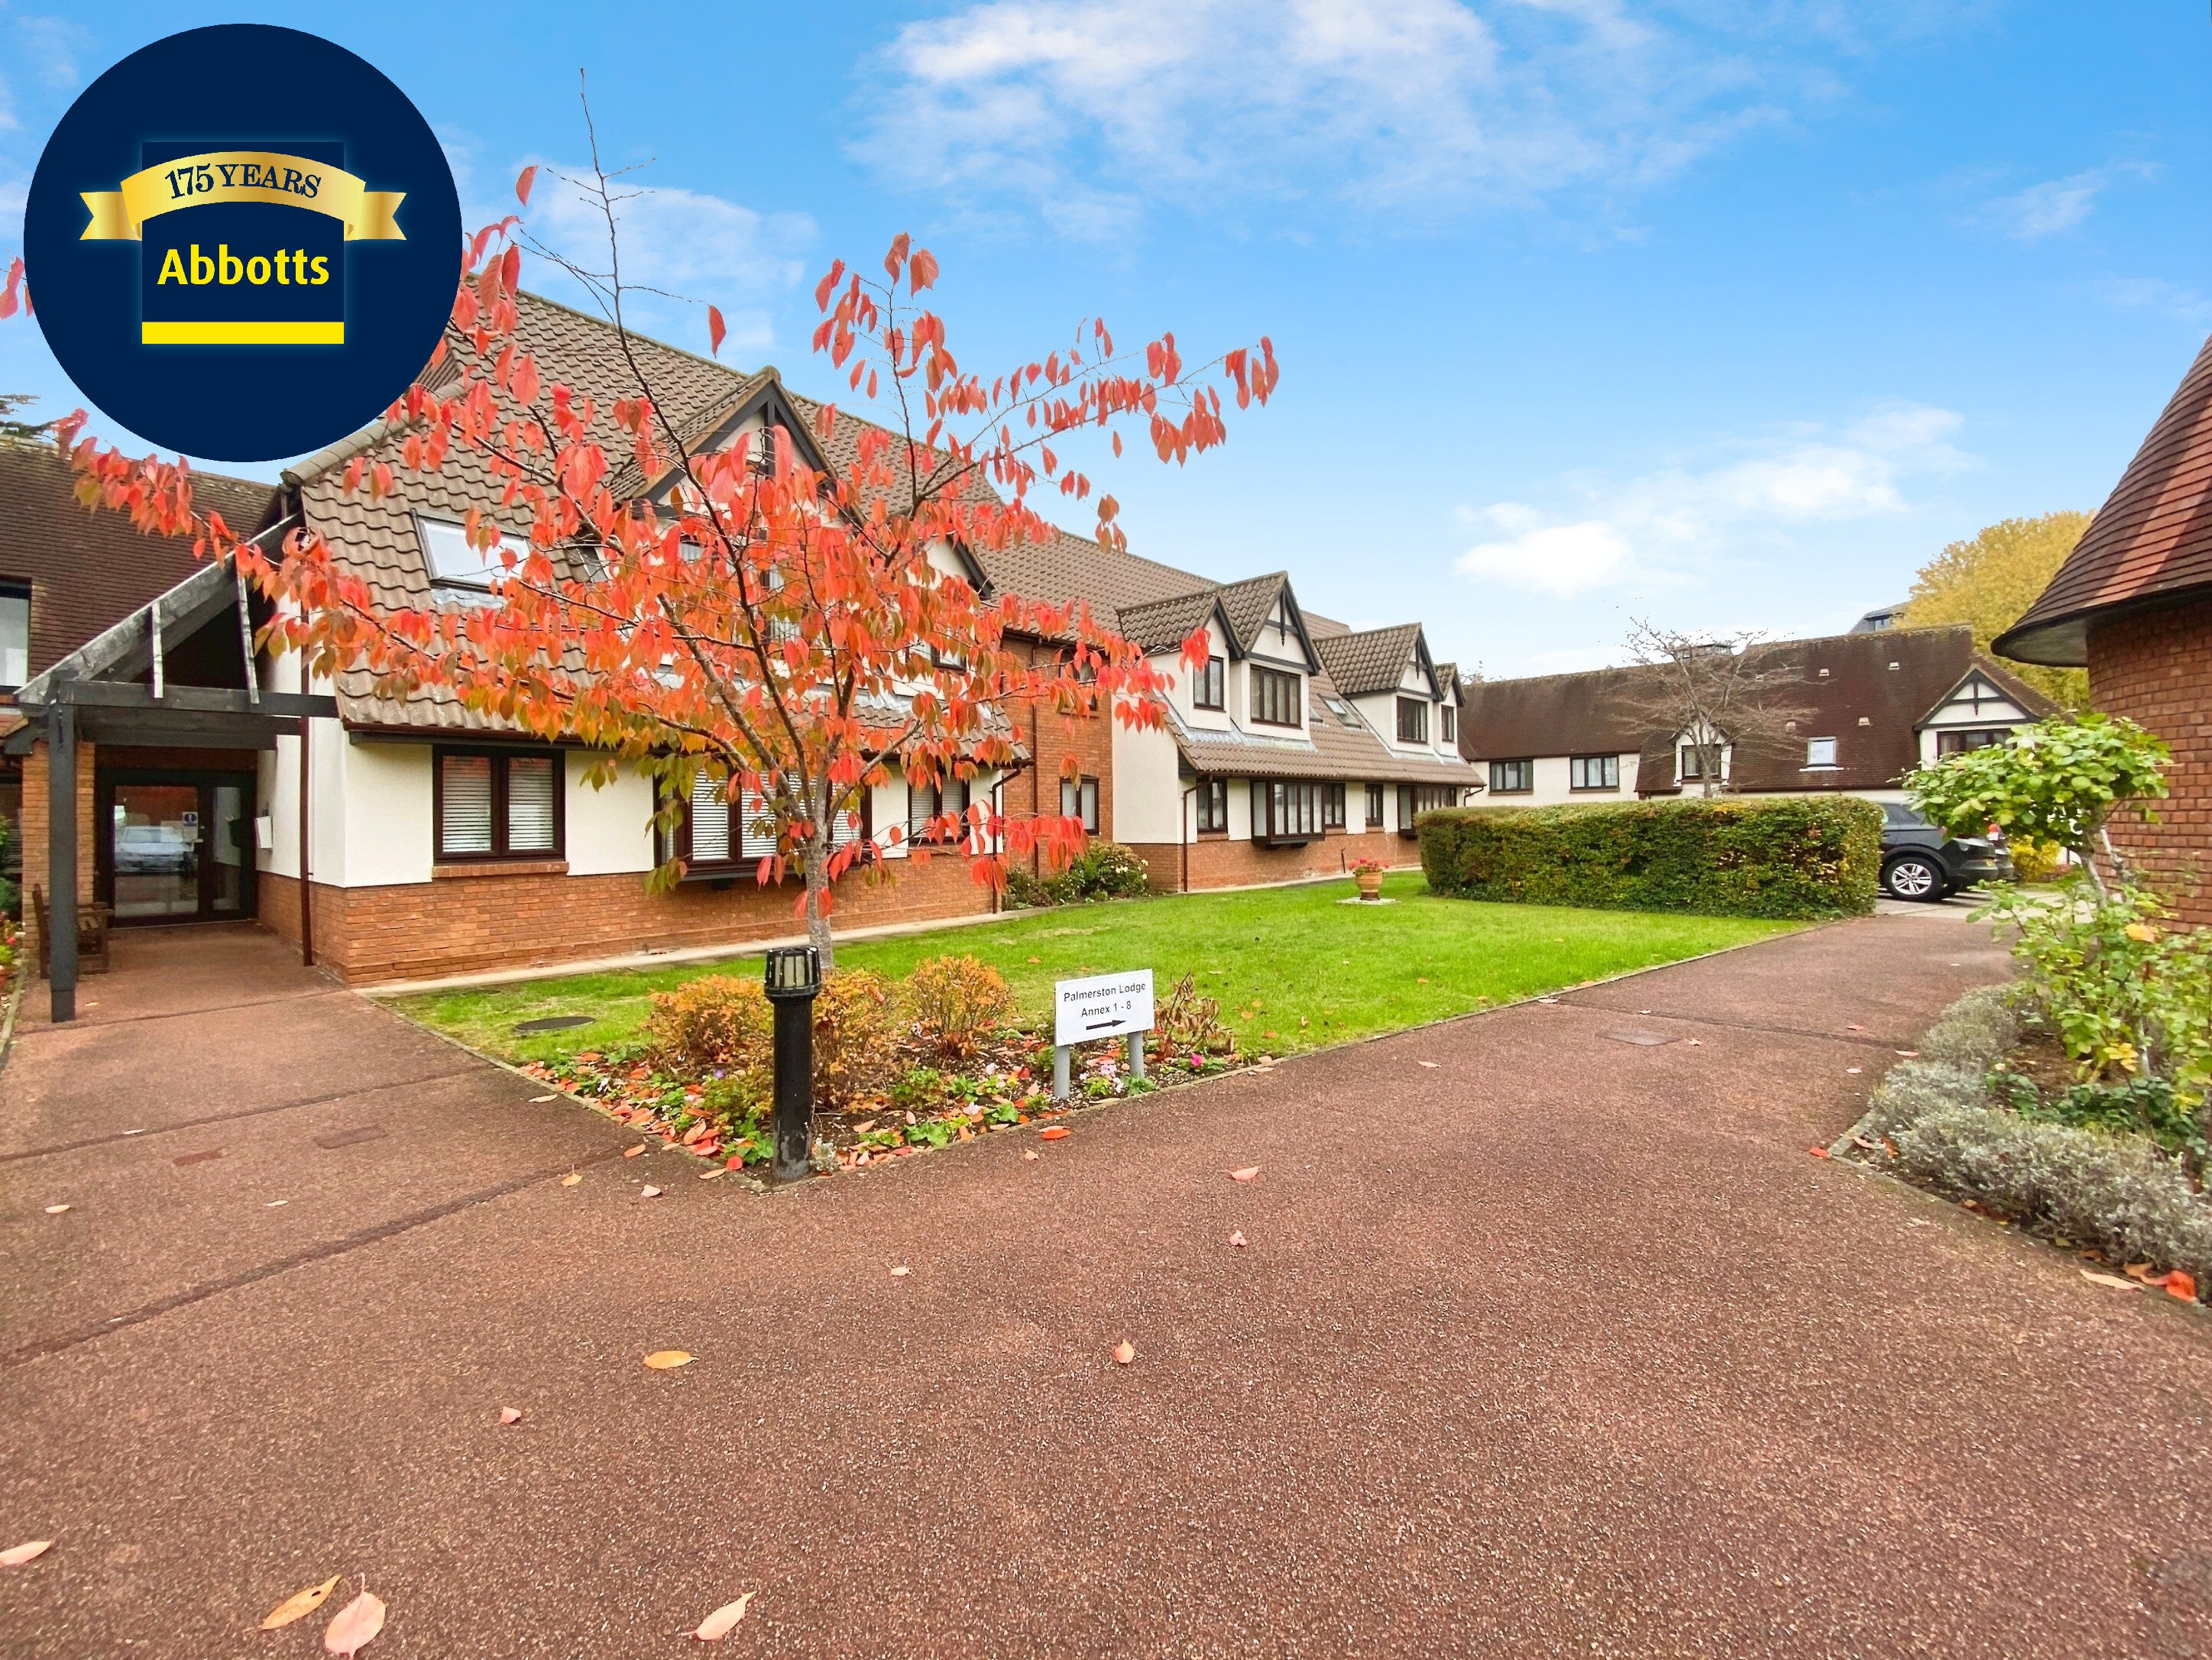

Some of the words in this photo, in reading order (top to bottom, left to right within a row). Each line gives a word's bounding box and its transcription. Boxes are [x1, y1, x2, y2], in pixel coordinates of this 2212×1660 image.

[1064, 988, 1116, 1002] Palmerston
[1119, 983, 1146, 994] Lodge
[1080, 1005, 1110, 1018] Annex
[1113, 1003, 1117, 1011] 1
[1126, 1001, 1132, 1009] 8
